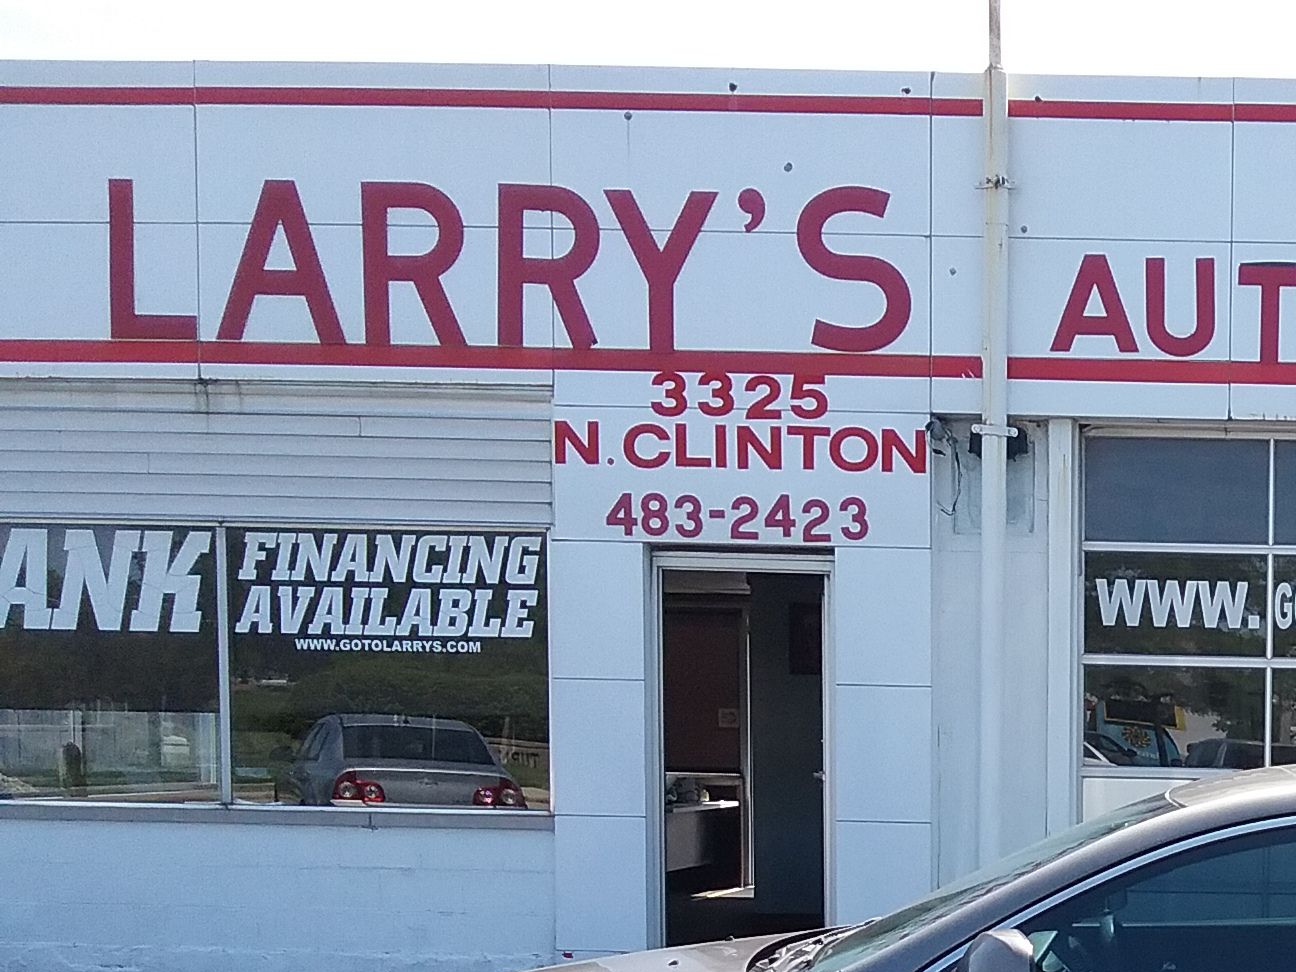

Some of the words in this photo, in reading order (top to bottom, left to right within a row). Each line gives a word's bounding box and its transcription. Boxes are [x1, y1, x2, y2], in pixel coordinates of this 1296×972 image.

[108, 178, 912, 353] LARRY'S
[650, 369, 830, 421] 3325
[605, 491, 869, 543] 483-2423
[0, 527, 213, 633] ANK
[237, 531, 543, 585] FINANCING
[234, 585, 540, 638] AVAILABLE
[294, 637, 482, 654] WWW.GOTOLARRYS.COM
